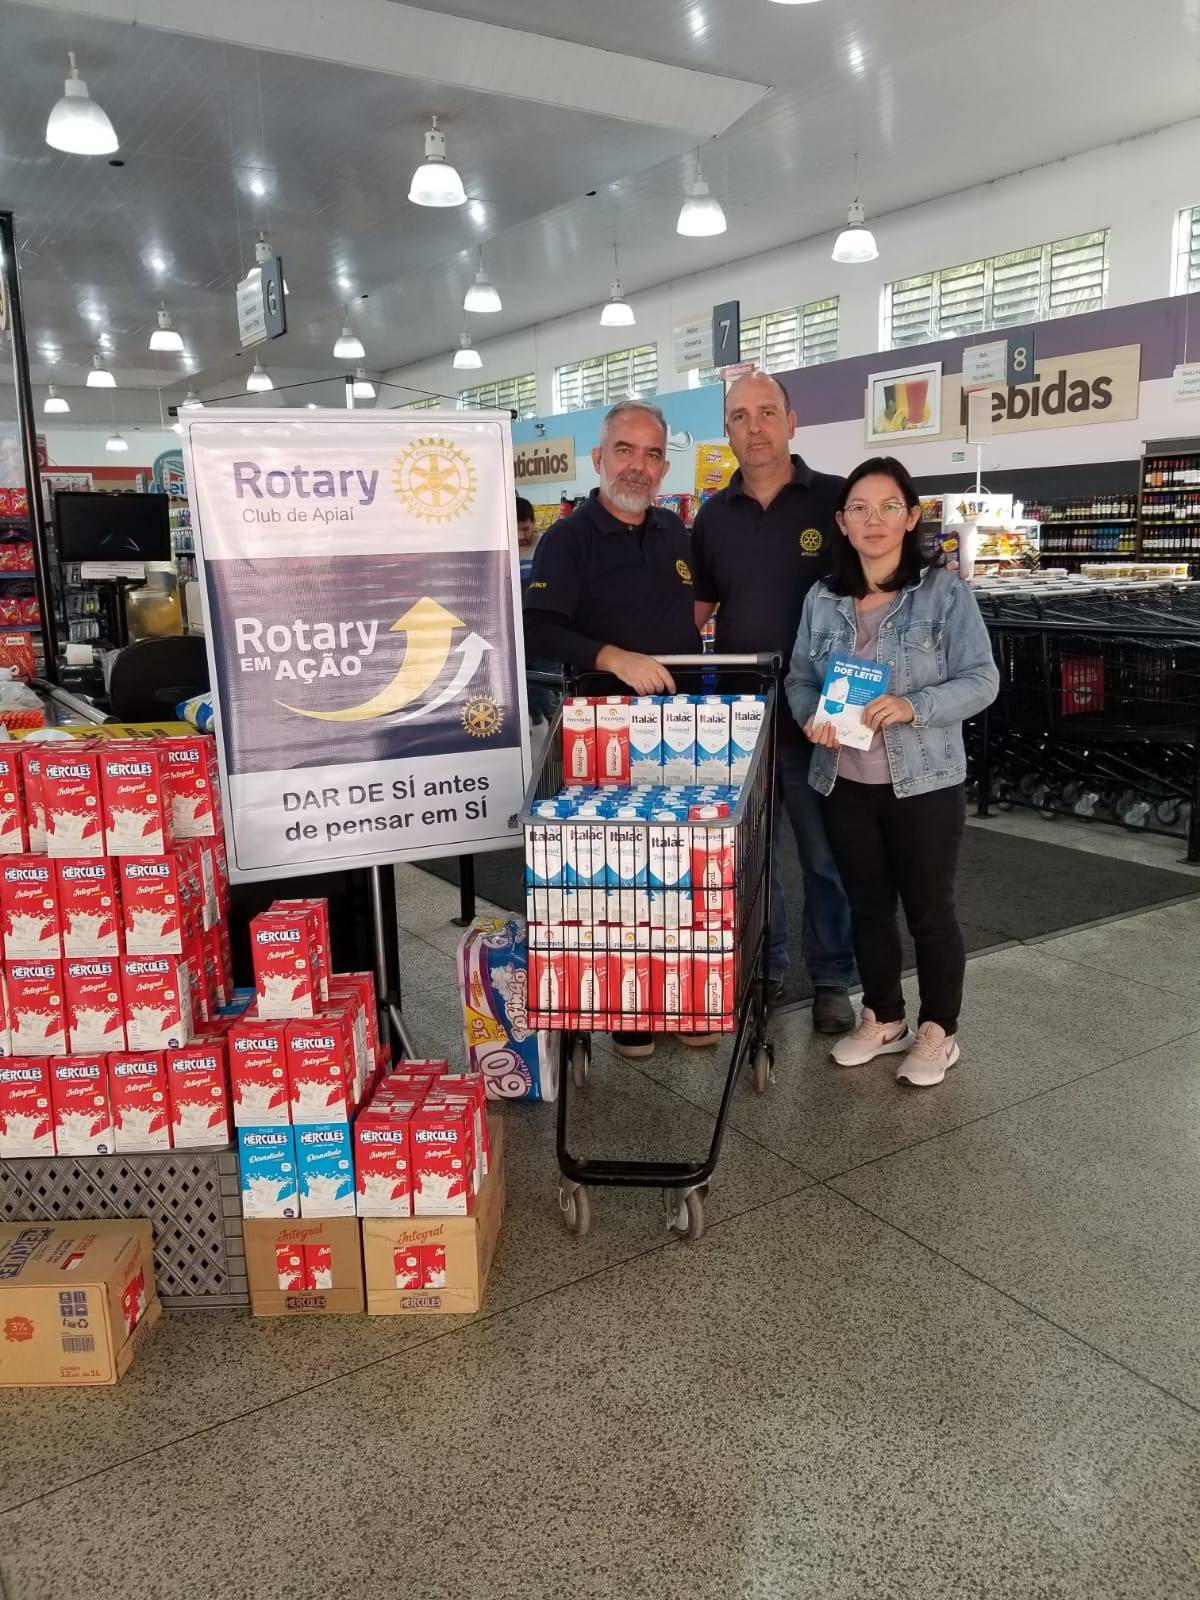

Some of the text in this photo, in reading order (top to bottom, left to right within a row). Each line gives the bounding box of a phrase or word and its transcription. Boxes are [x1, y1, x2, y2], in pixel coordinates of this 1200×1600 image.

[268, 280, 276, 316] 6
[719, 320, 730, 349] 7
[1013, 347, 1027, 371] 8
[514, 447, 568, 478] ticínios
[233, 460, 379, 505] Rotary
[243, 505, 355, 524] Club de Apiaí
[234, 617, 379, 658] Rotary
[240, 652, 362, 684] EM AÇÃO
[834, 666, 853, 676] DOE
[632, 715, 657, 724] Italac
[666, 713, 692, 722] Italac
[700, 715, 726, 723] Italac
[735, 711, 761, 720] Italac
[168, 749, 199, 763] RCULES
[57, 784, 86, 797] Integral
[117, 781, 146, 794] Integral
[283, 774, 490, 812] DAR DE SÍ antes
[285, 798, 487, 842] de pensar em SÍ
[610, 831, 643, 842] Italac
[652, 837, 685, 848] Italac
[15, 886, 43, 899] Integral
[73, 884, 100, 897] Integral
[136, 883, 164, 897] Integral
[267, 947, 295, 960] Integral
[22, 983, 49, 996] Integral
[79, 980, 107, 994] Integral
[136, 979, 164, 992] Integral
[471, 1018, 491, 1040] 16
[244, 1056, 272, 1068] Integral
[301, 1055, 329, 1067] Integral
[480, 1050, 529, 1099] 60
[124, 1080, 152, 1093] Integral
[183, 1075, 211, 1089] Integral
[9, 1086, 37, 1099] Integral
[66, 1084, 94, 1097] Integral
[369, 1148, 397, 1160] Integral
[425, 1147, 452, 1159] Integral
[278, 1223, 324, 1243] Integral
[397, 1224, 444, 1244] Integral
